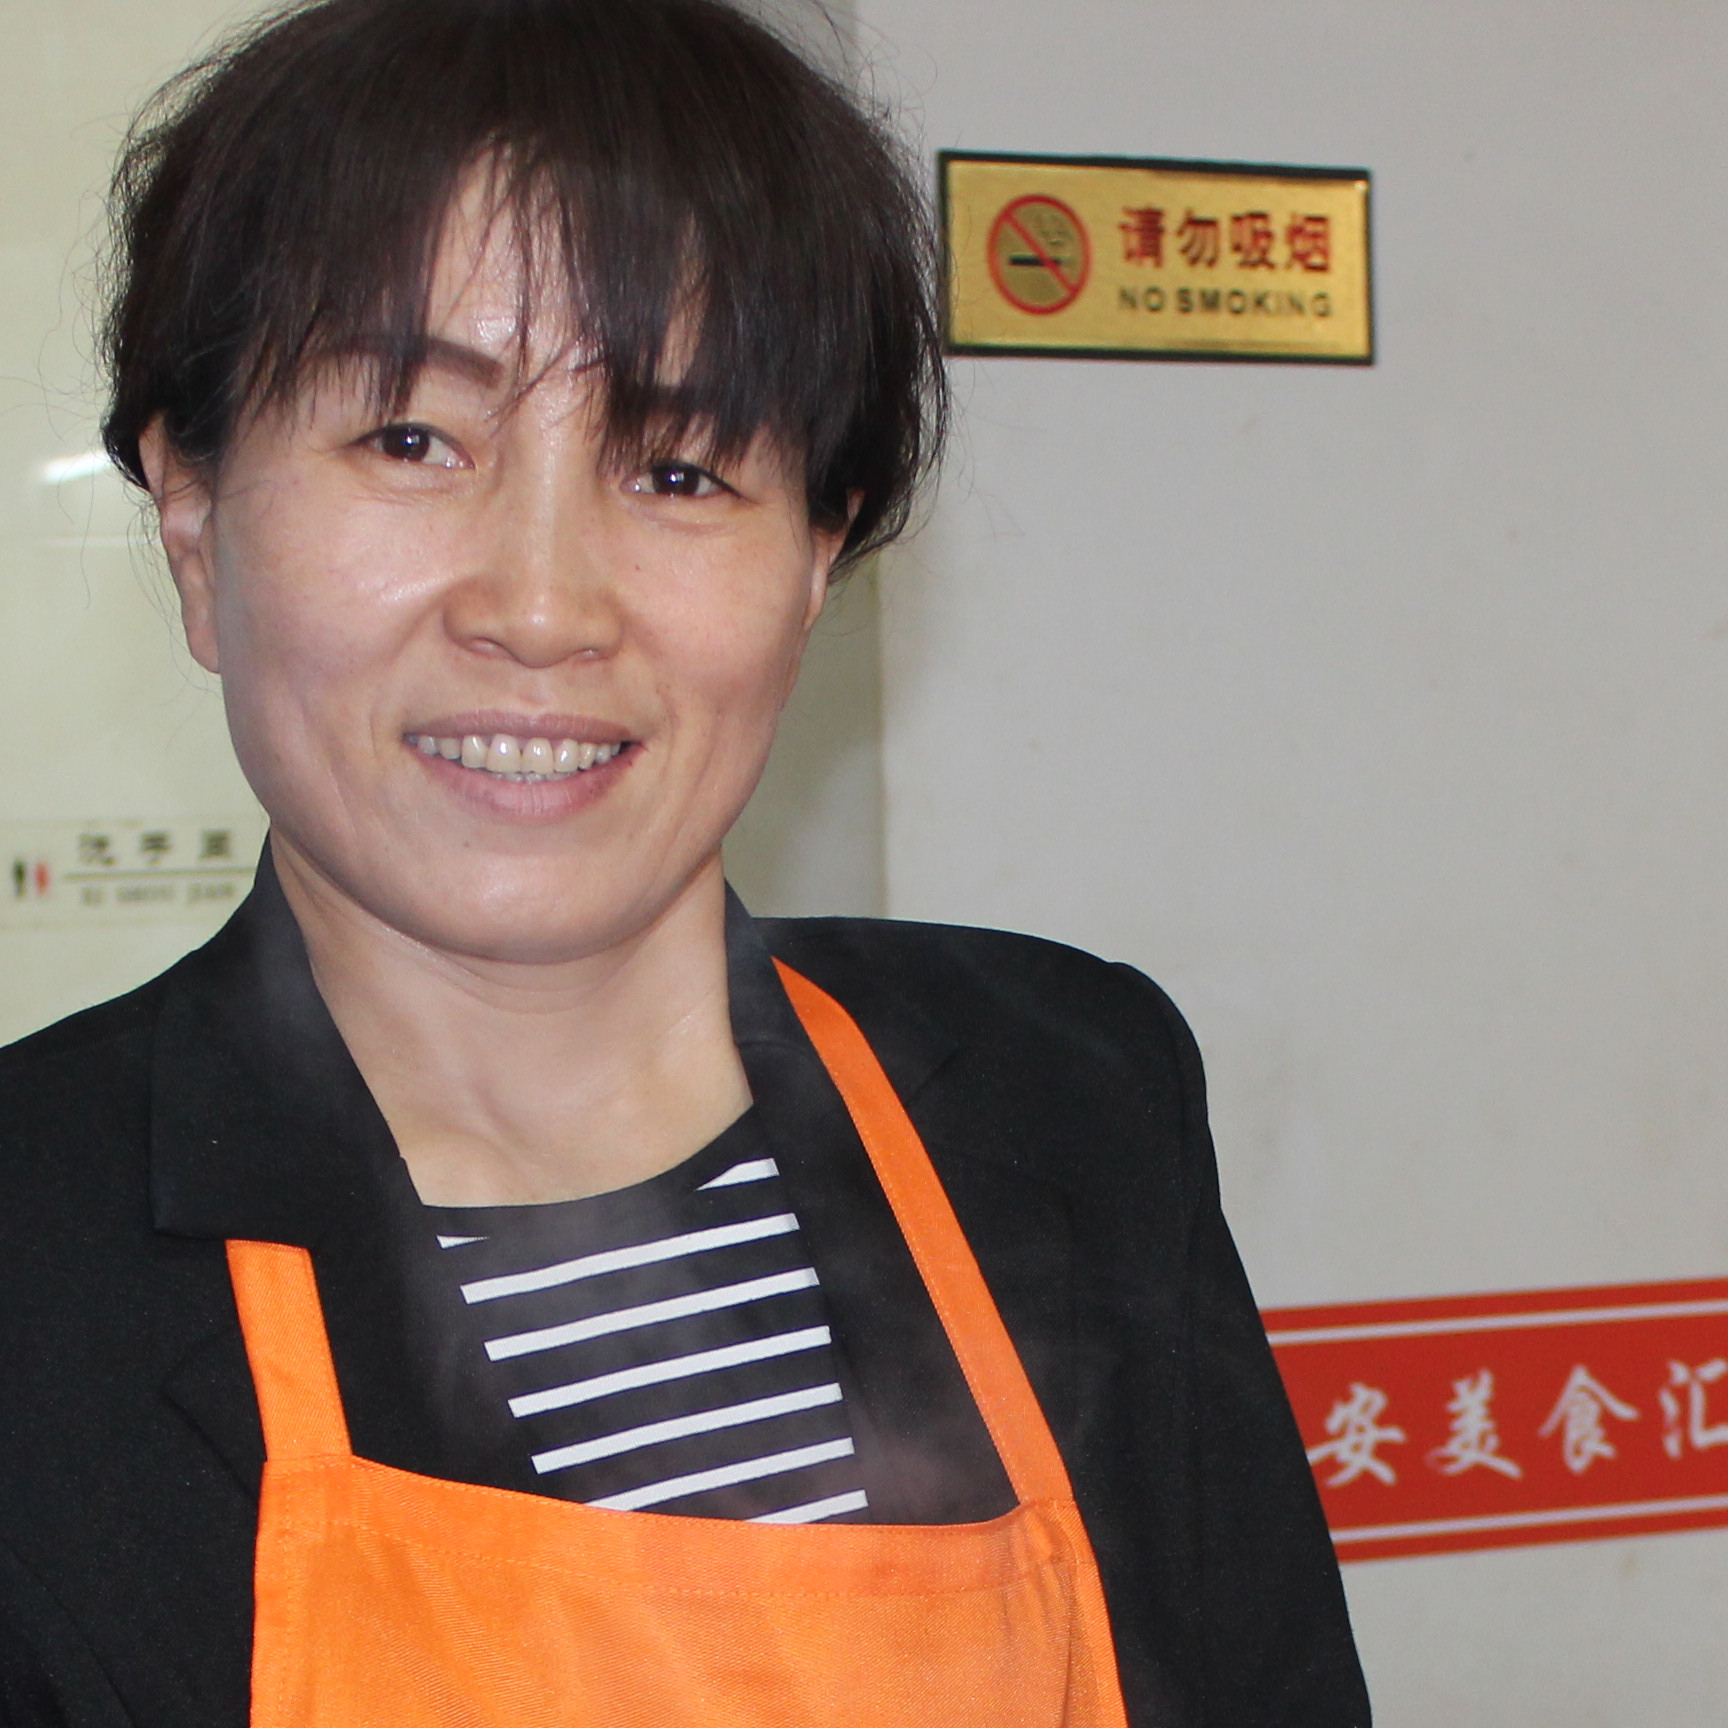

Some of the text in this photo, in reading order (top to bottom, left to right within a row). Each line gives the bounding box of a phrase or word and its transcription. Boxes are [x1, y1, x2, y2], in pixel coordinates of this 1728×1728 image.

[1117, 205, 1333, 273] 请勿吸烟
[1119, 286, 1333, 318] NO SMOKING
